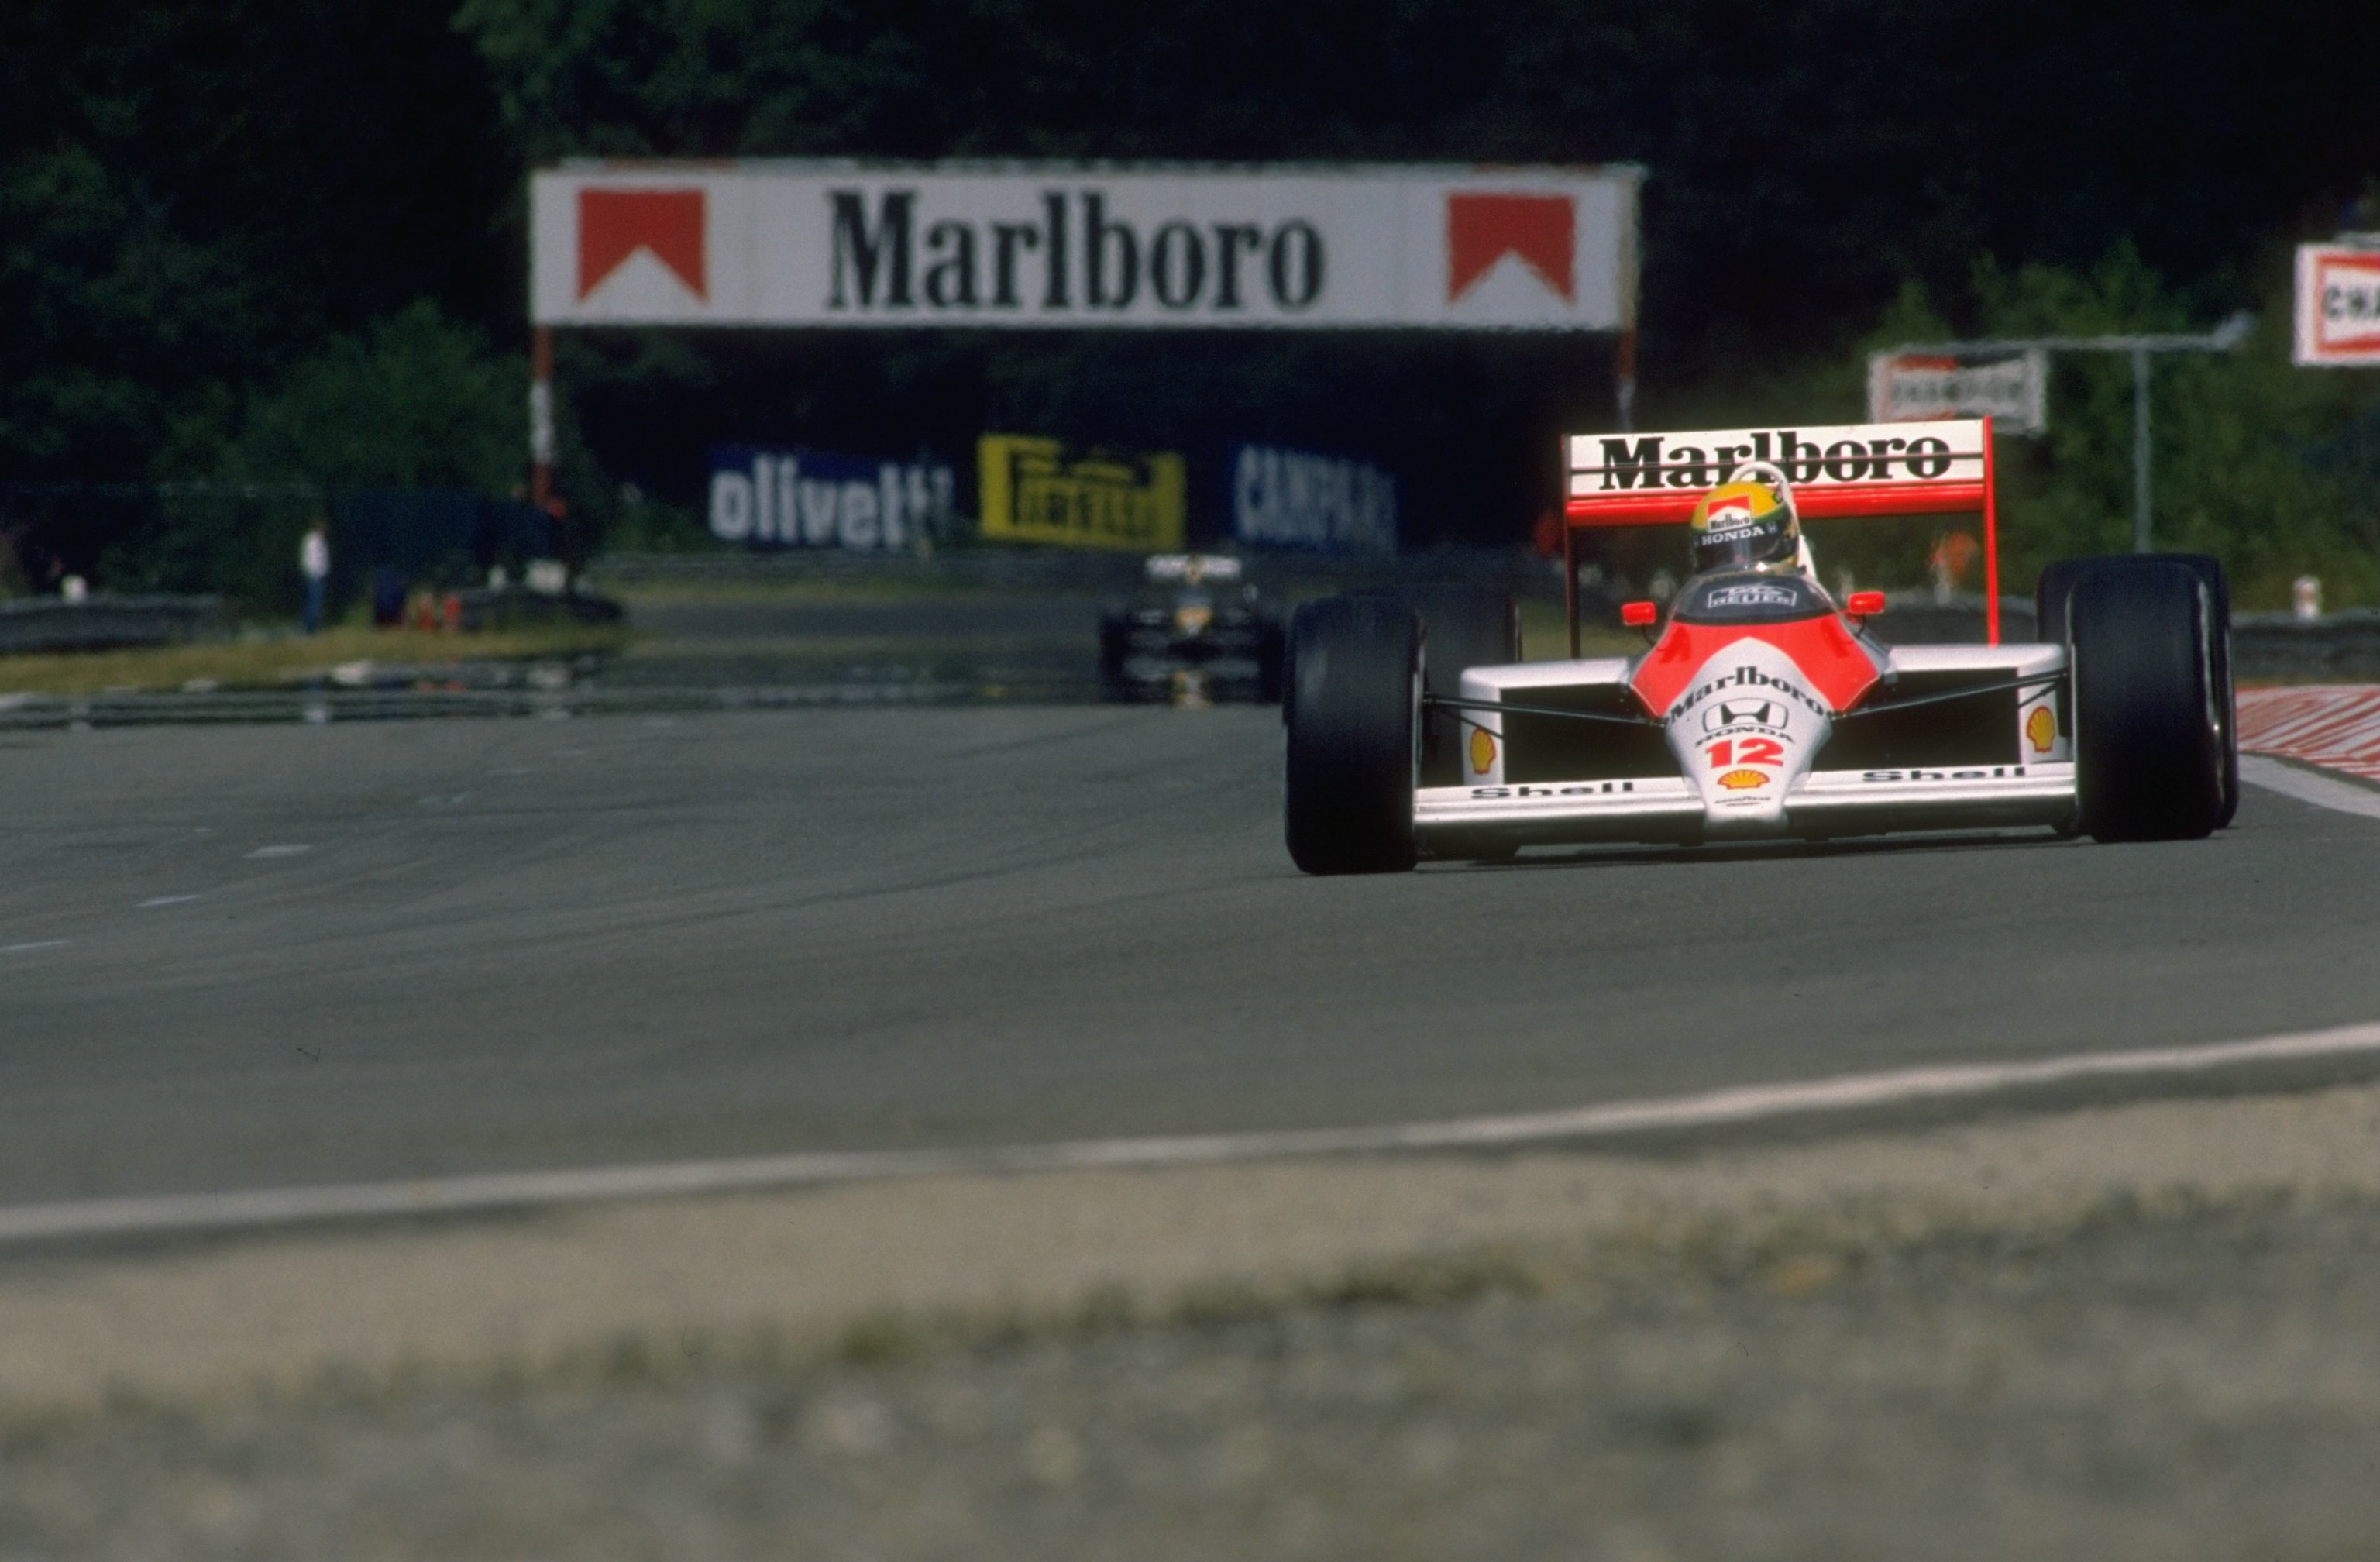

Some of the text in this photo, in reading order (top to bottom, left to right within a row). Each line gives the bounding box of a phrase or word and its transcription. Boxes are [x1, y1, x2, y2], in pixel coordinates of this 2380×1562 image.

[826, 190, 1325, 309] Marlboro
[1598, 432, 1951, 490] Marlboro
[1710, 513, 1751, 529] Marlboro
[1701, 526, 1765, 545] HONDA
[1667, 666, 1825, 724] Marlboro
[1695, 726, 1795, 748] HONDA
[1705, 738, 1784, 768] 12
[1862, 766, 2025, 782] Shell
[1470, 782, 1633, 799] Shell
